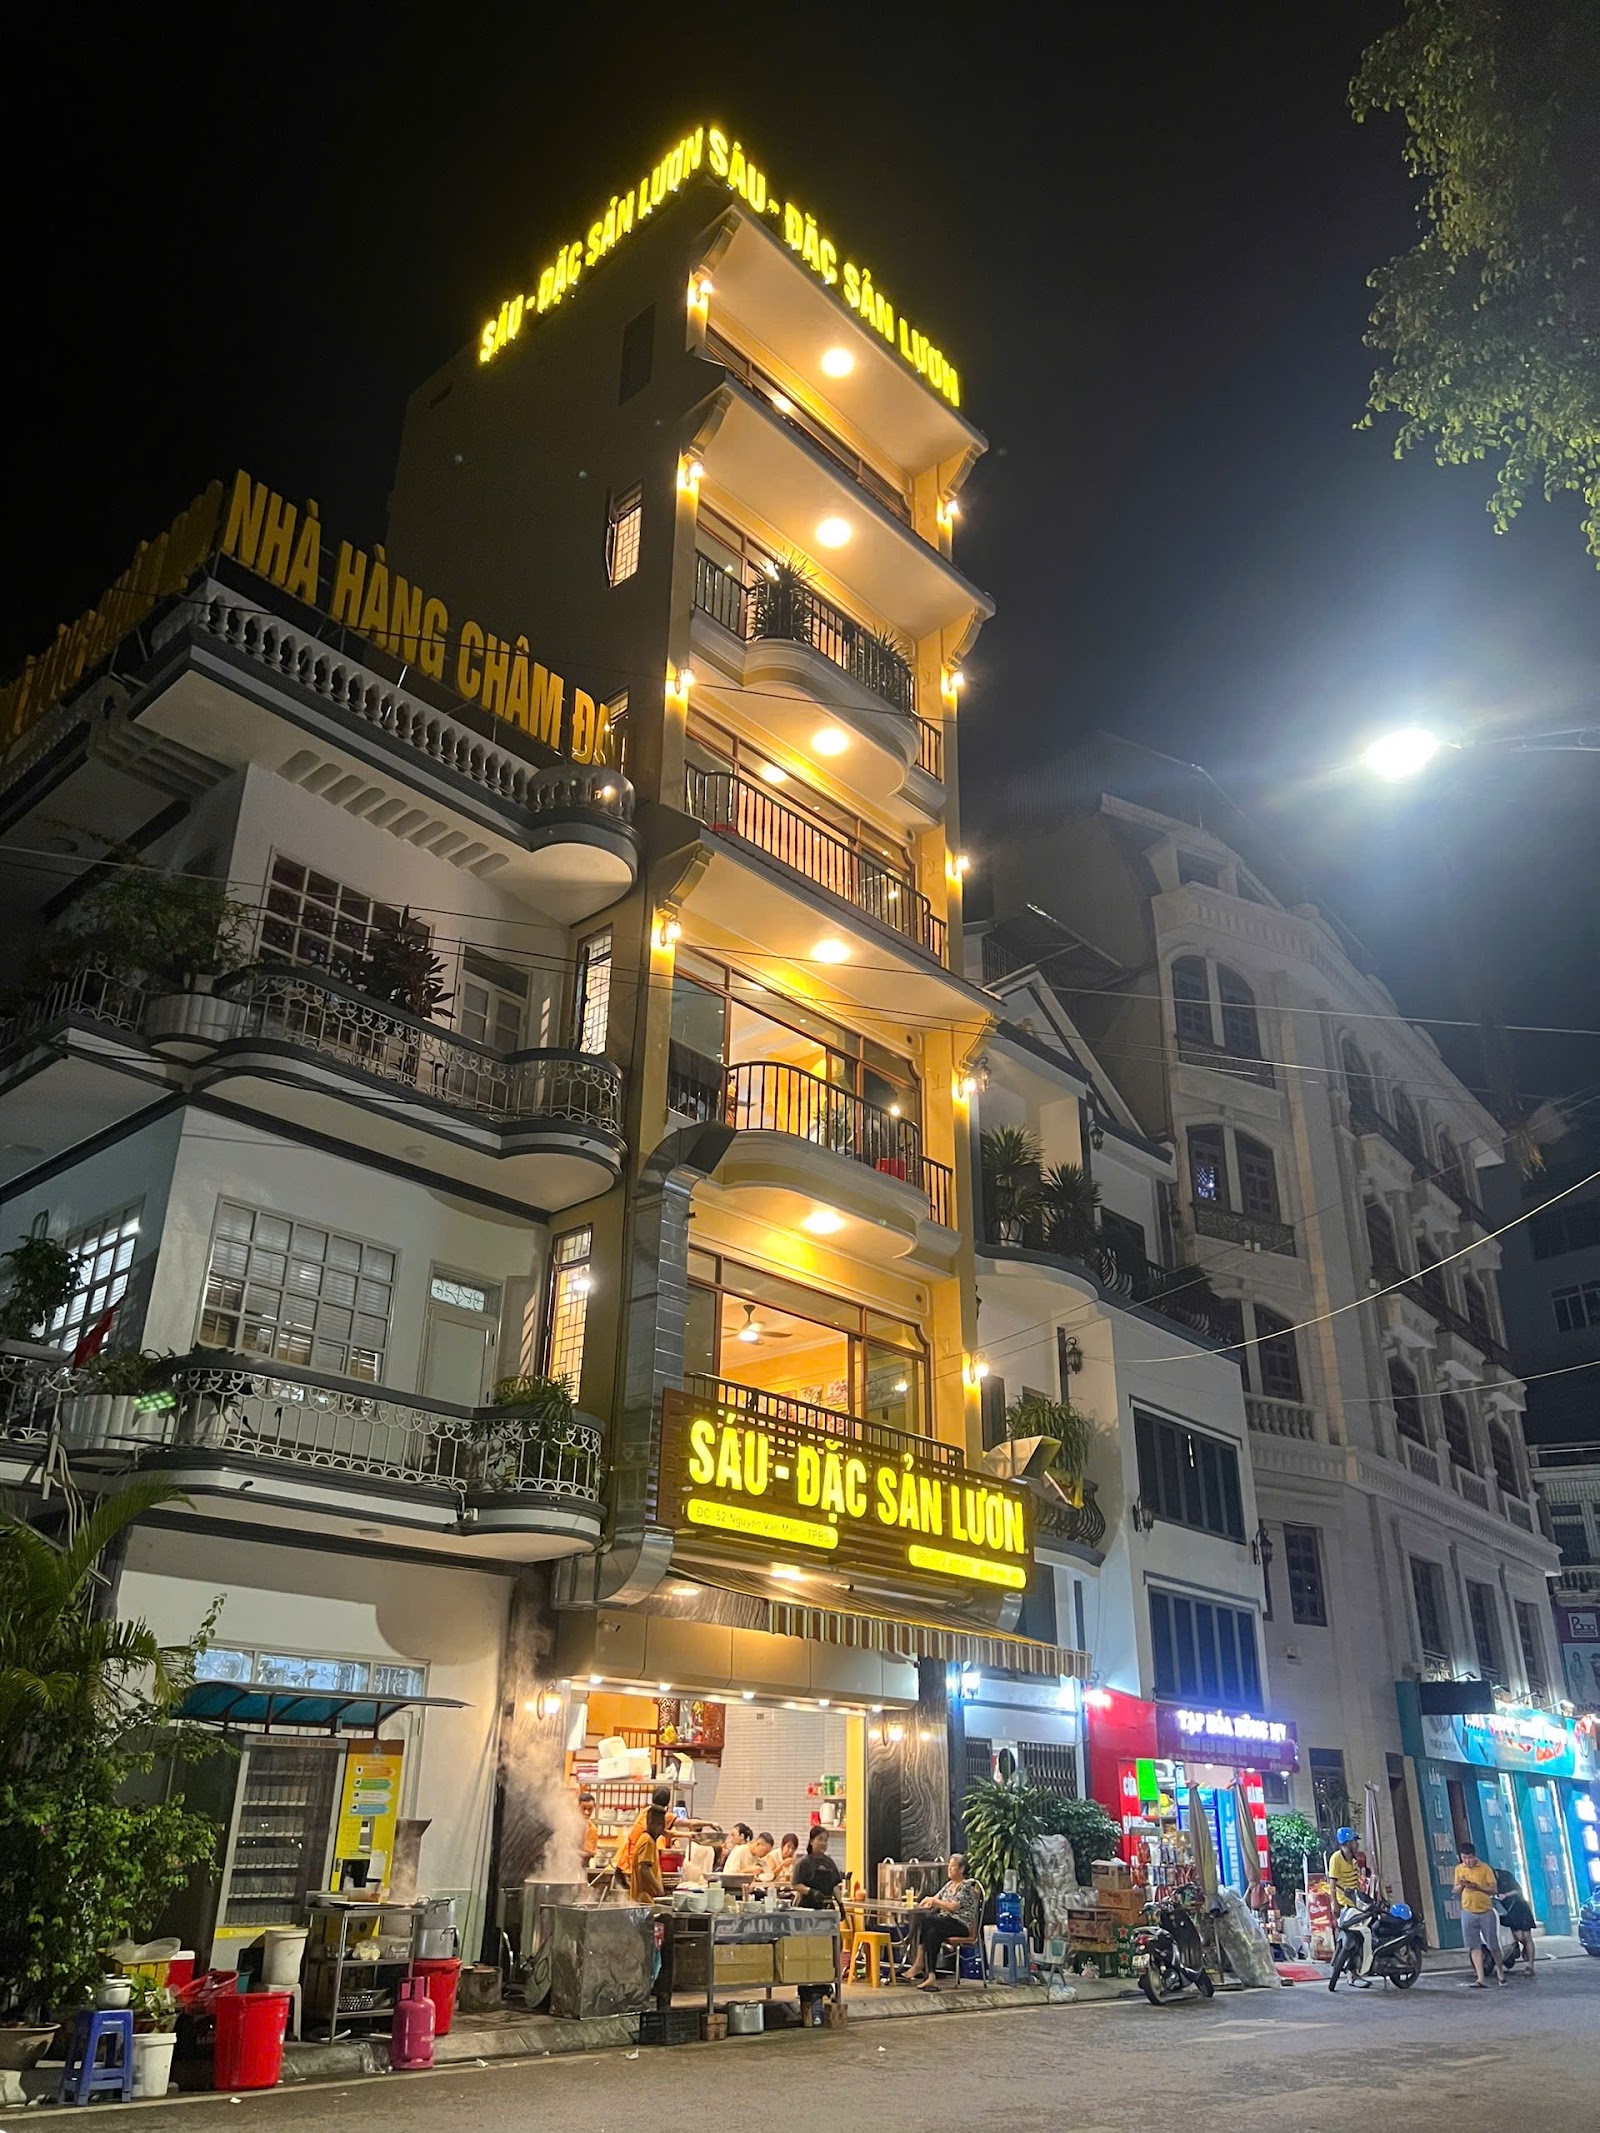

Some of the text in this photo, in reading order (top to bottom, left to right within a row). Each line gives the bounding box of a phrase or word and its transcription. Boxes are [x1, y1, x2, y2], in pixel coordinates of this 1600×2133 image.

[480, 294, 524, 362] SÁU
[709, 128, 766, 213] SÁU
[843, 262, 895, 343] SẢN
[899, 317, 960, 408] LƯƠN
[222, 468, 321, 606] NHÀ
[330, 539, 450, 678] HÀNG
[457, 620, 564, 750] CHÂM
[688, 1413, 769, 1496] SÁU
[797, 1437, 867, 1524] ĐẶC
[876, 1452, 943, 1536] SẢN
[951, 1485, 1025, 1555] LƯƠN
